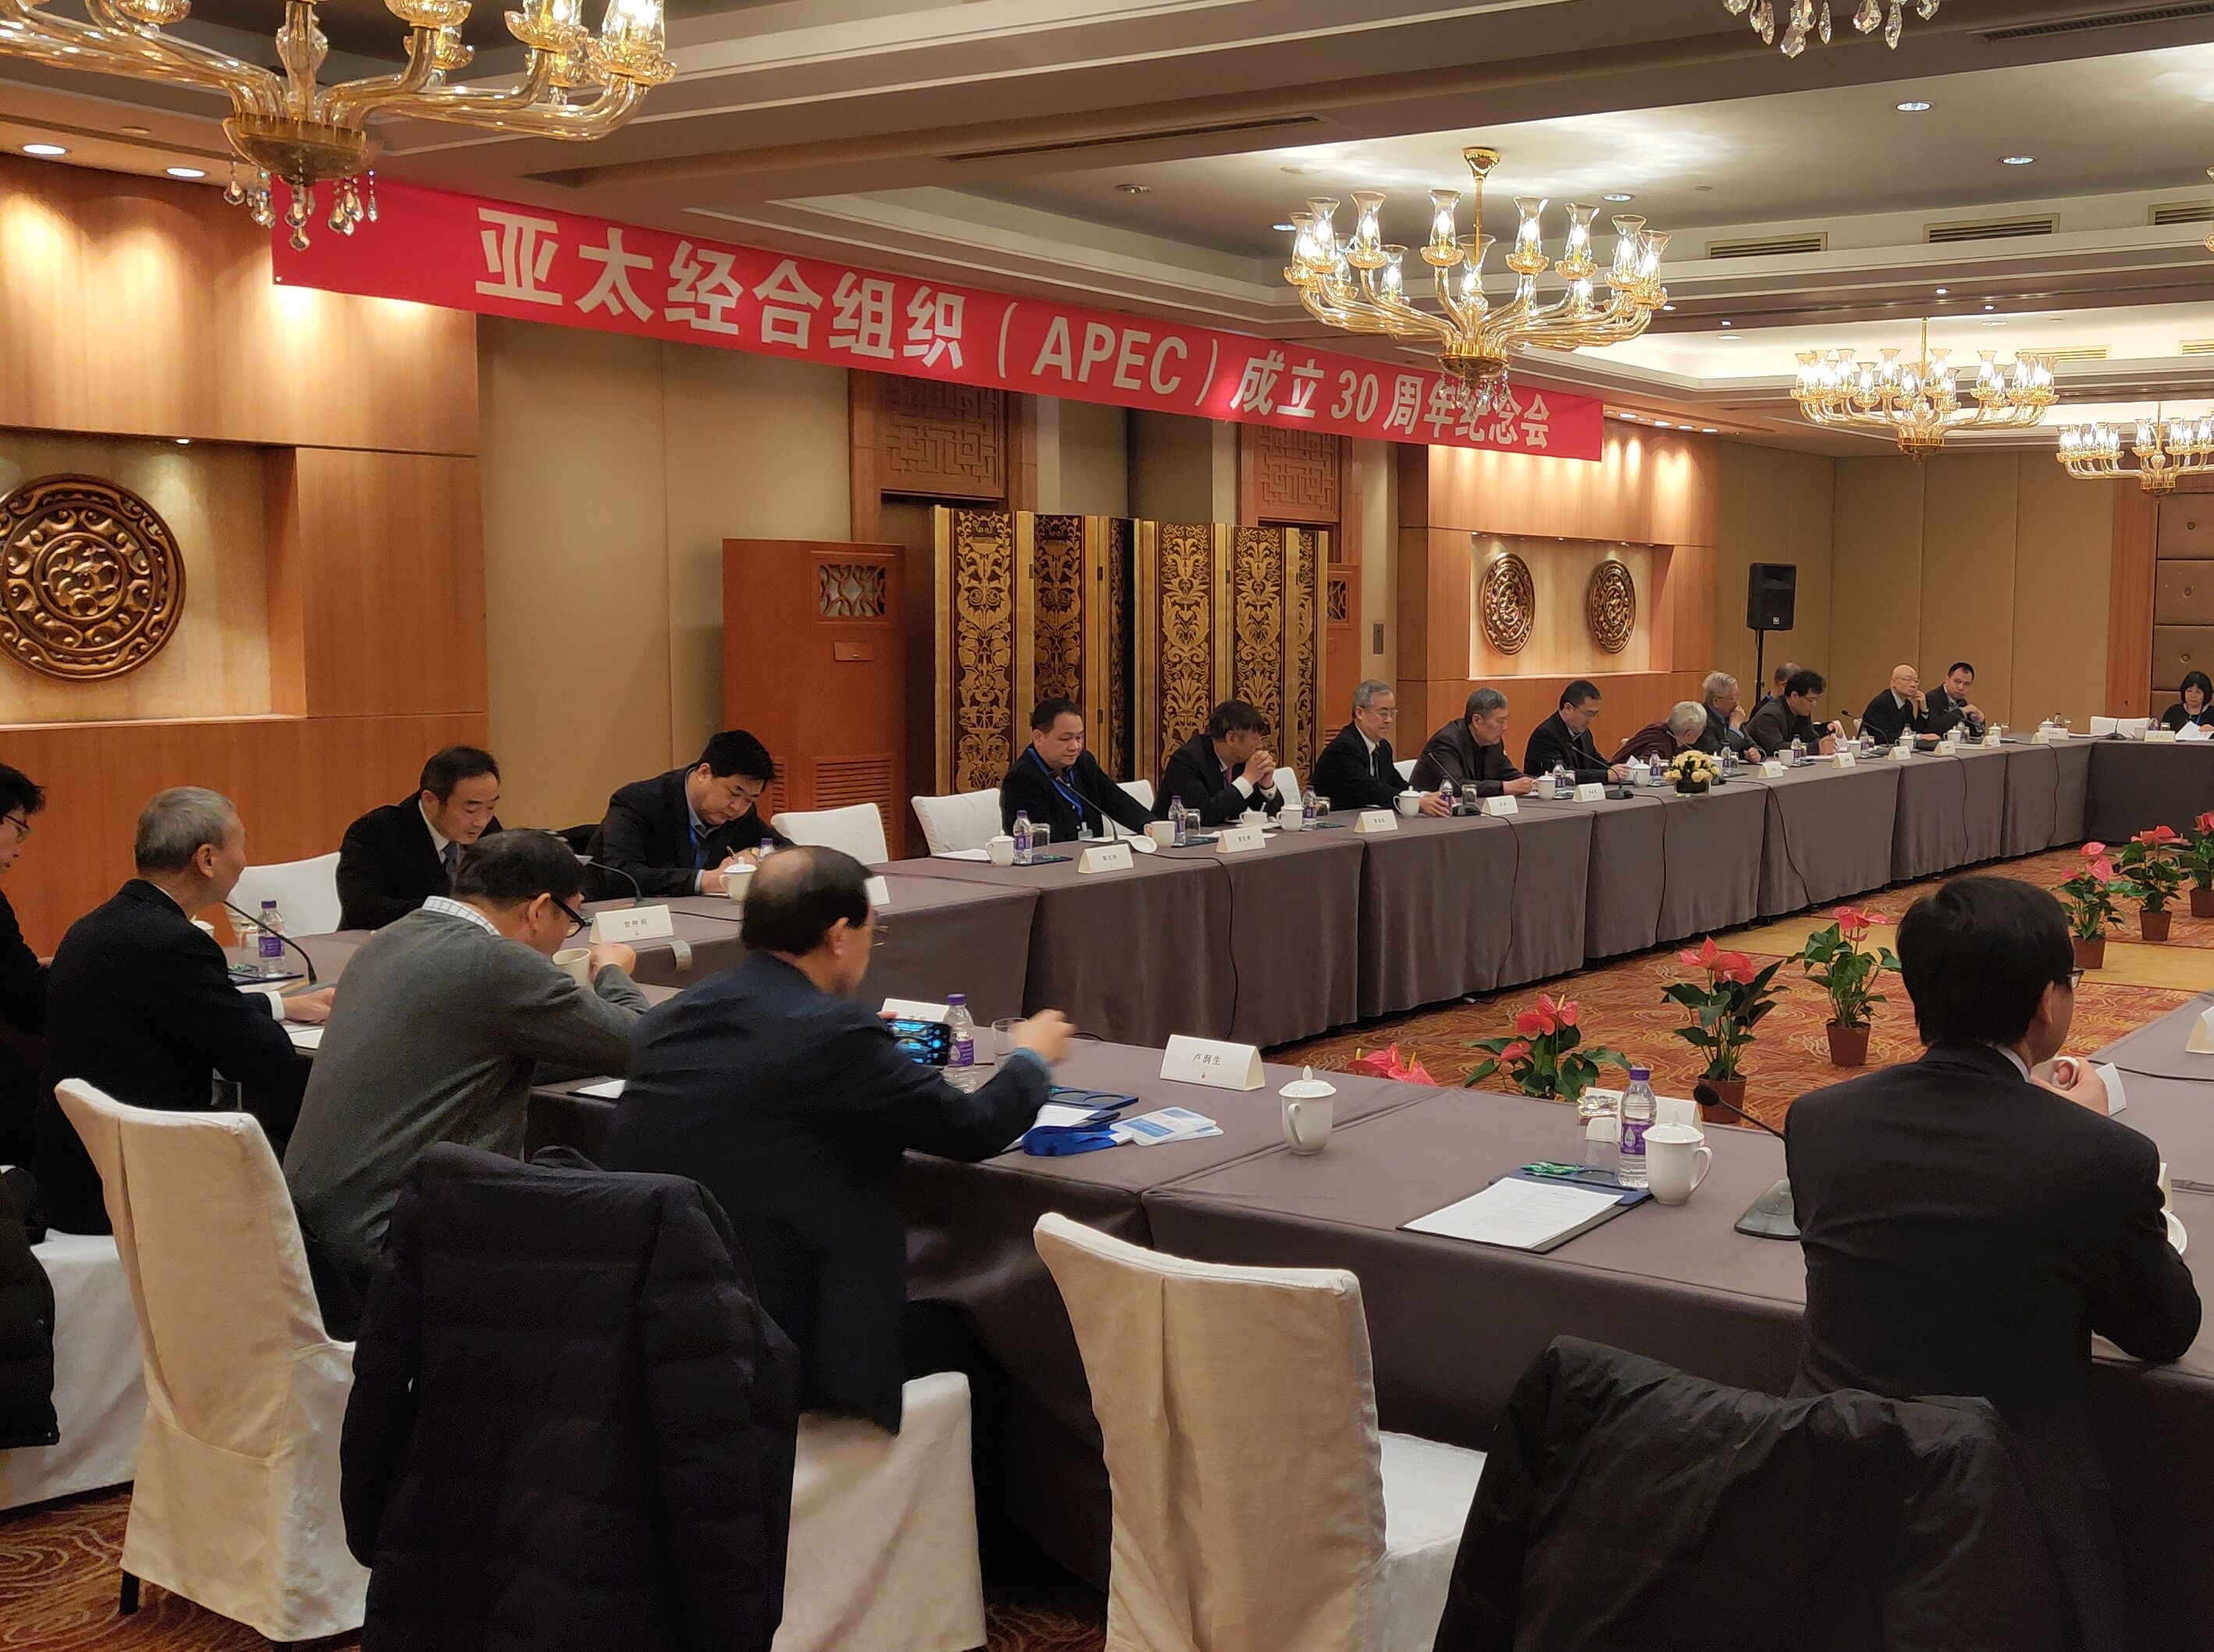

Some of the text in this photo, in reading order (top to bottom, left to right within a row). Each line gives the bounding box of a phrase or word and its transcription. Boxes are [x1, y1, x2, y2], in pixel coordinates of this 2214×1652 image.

[475, 207, 965, 370] 亚太经合组织
[1230, 349, 1325, 418] 成立
[1331, 369, 1379, 423] 30
